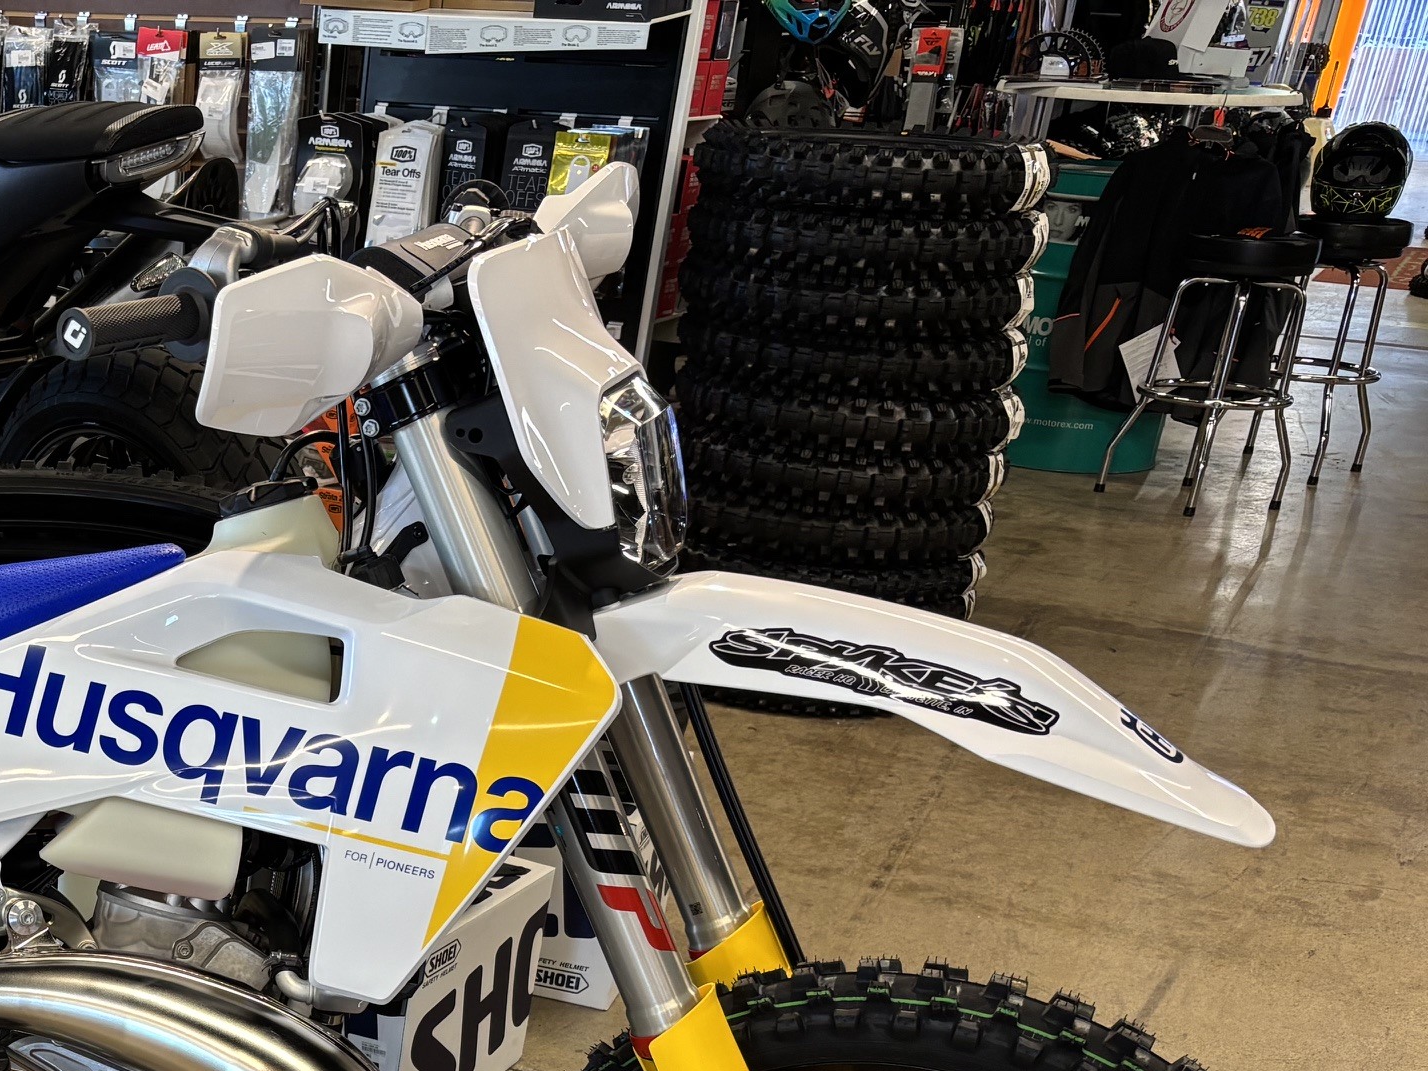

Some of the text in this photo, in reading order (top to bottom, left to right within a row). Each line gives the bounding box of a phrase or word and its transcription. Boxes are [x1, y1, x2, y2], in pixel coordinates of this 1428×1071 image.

[854, 34, 882, 56] FLY
[308, 137, 352, 148] ARMEGA
[394, 149, 414, 160] 100%
[381, 166, 421, 179] Tear Offs
[508, 173, 548, 192] TEAR
[785, 664, 834, 681] RACER
[953, 705, 974, 716] IN
[344, 849, 436, 880] FOR PIONEERS
[428, 942, 458, 973] SHOEI
[559, 961, 590, 972] HELMET
[422, 962, 458, 989] SAFETY HELMET
[535, 970, 581, 990] SHOEI
